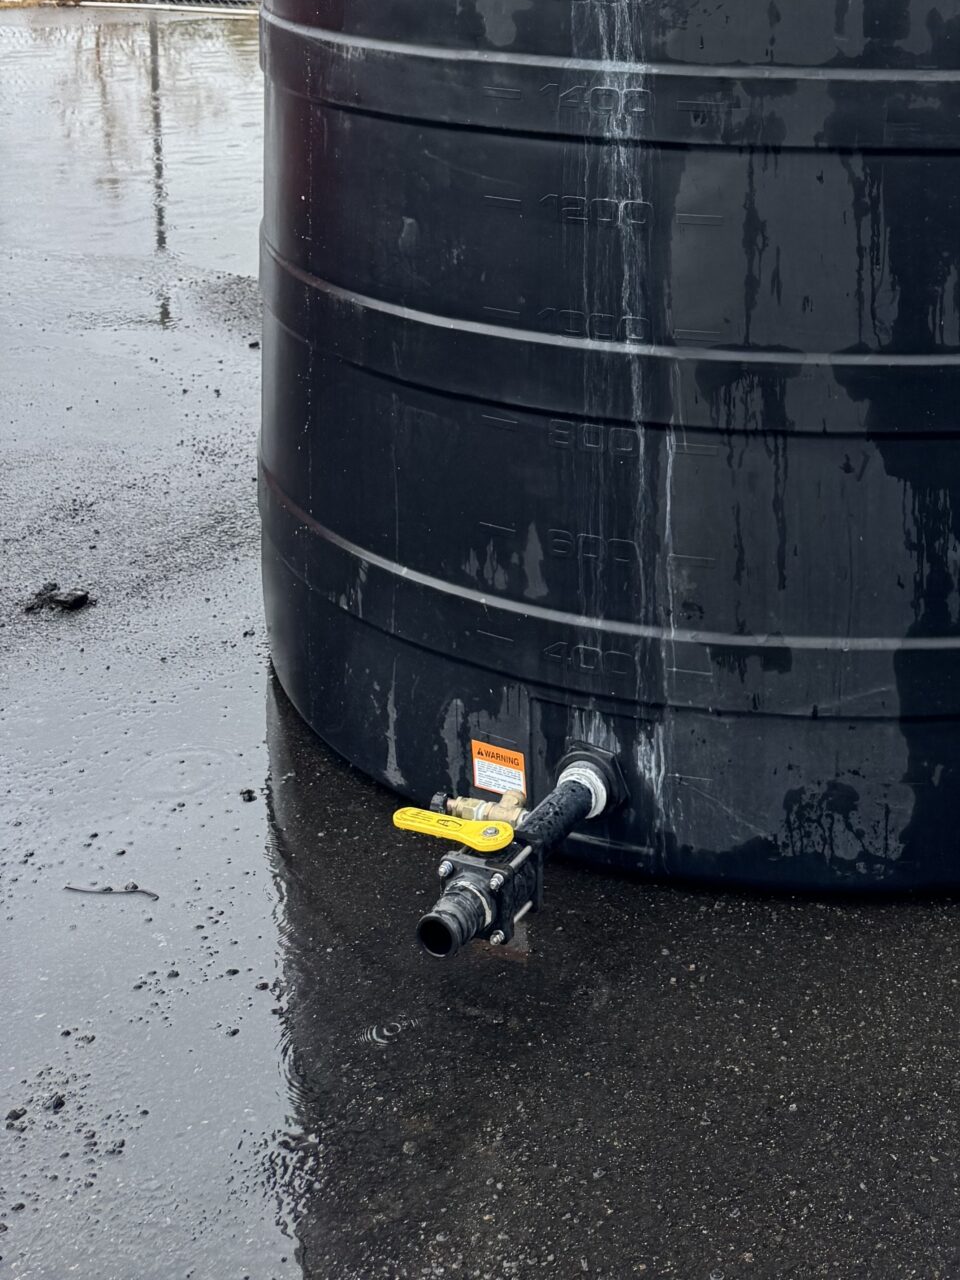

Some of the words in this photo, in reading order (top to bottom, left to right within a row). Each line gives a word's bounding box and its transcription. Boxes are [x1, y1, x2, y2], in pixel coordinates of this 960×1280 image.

[538, 83, 656, 116] 1400
[538, 194, 656, 227] 1200
[548, 418, 640, 458] 800
[547, 528, 640, 566] 600
[543, 641, 637, 679] 400
[484, 750, 520, 767] WARNING
